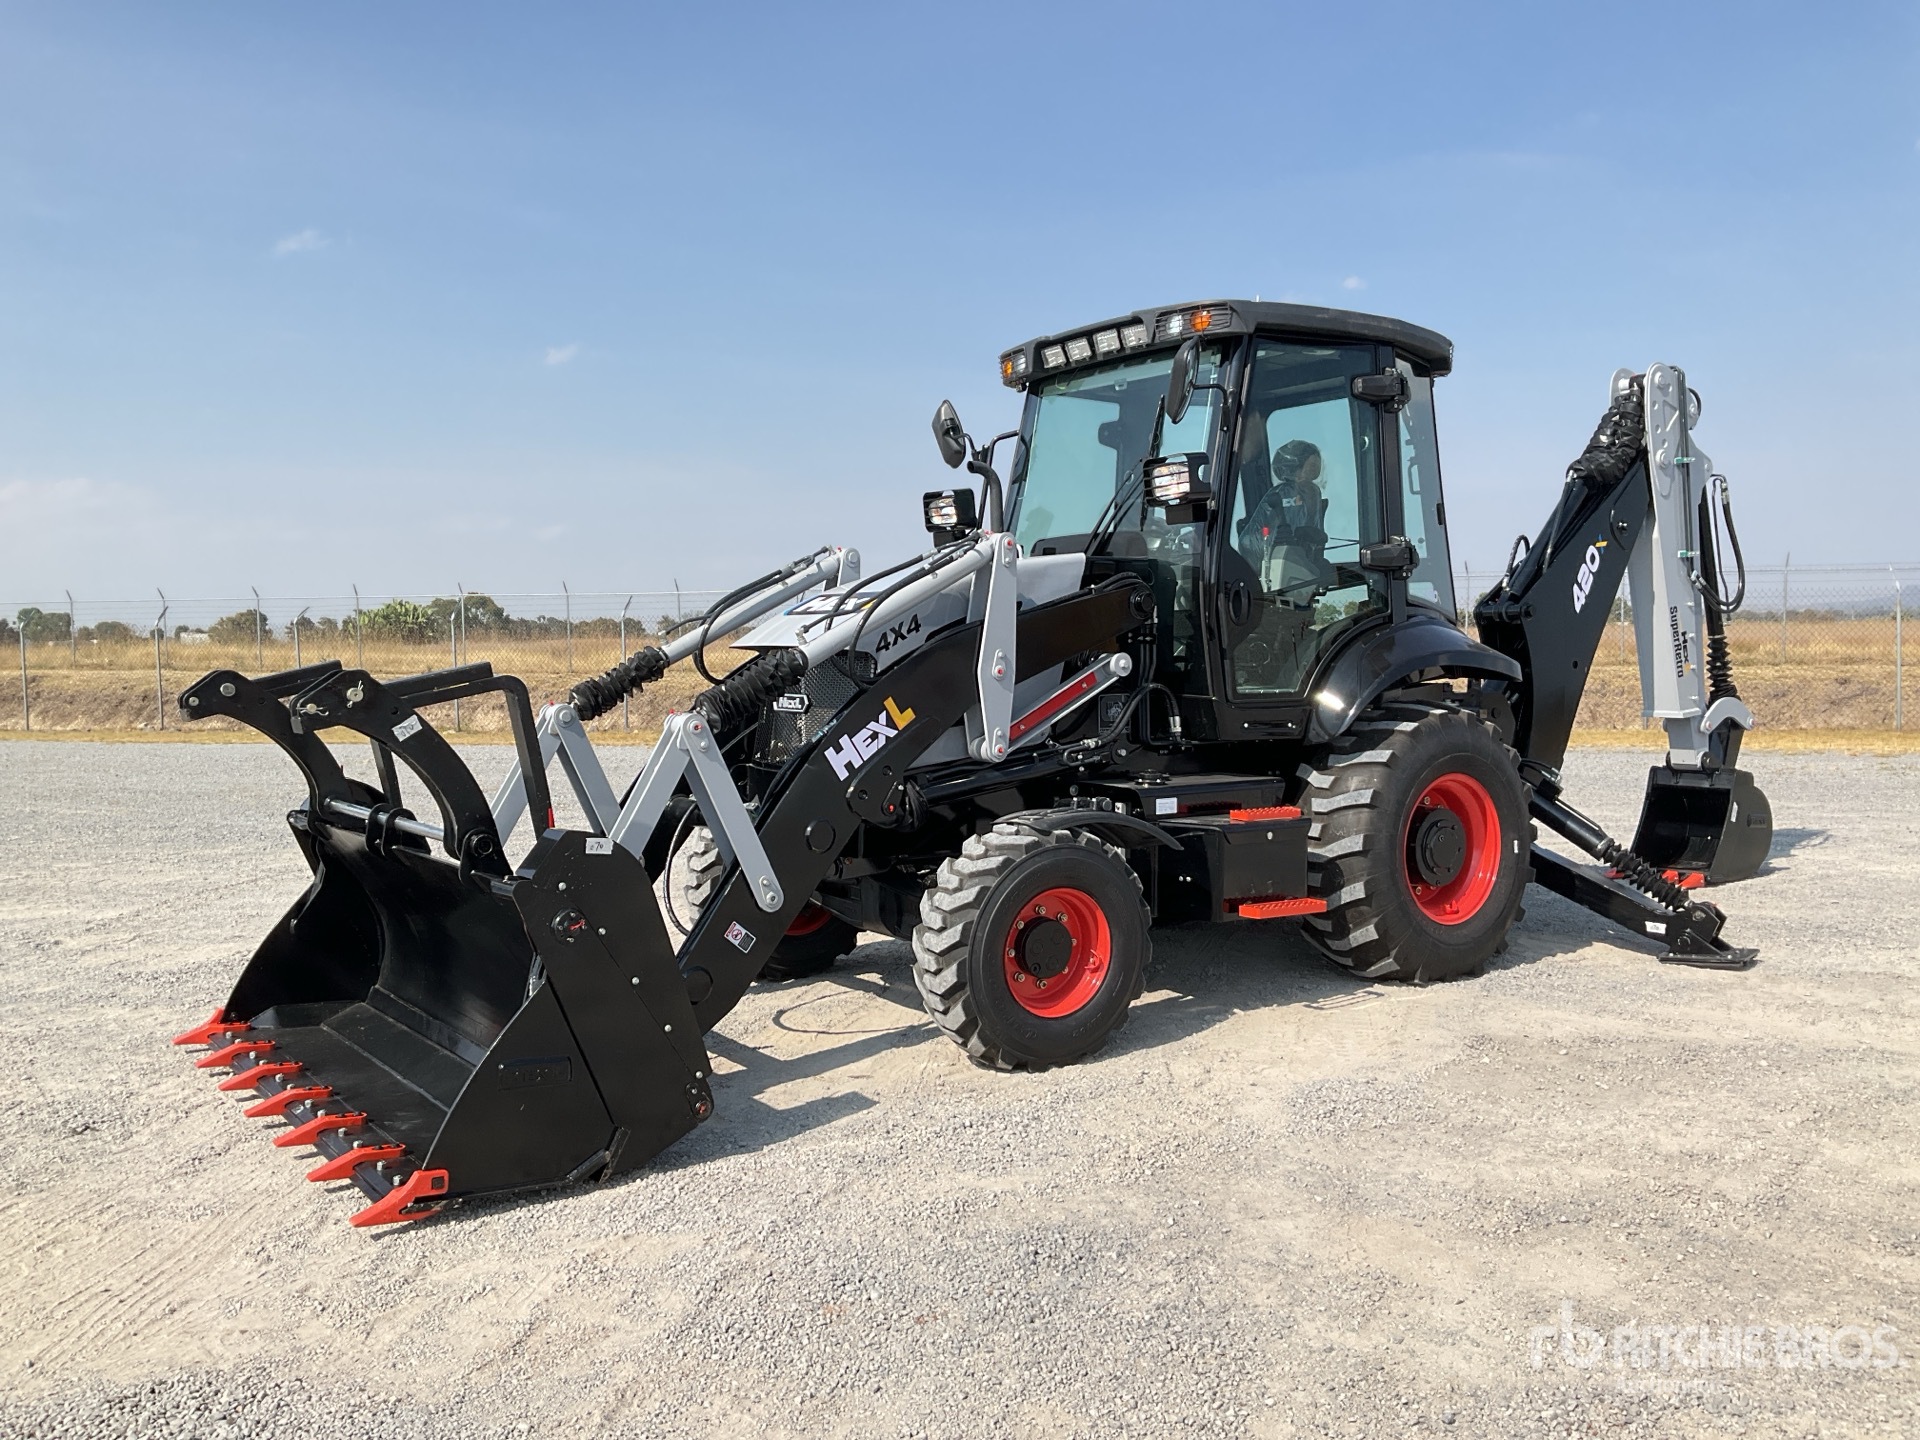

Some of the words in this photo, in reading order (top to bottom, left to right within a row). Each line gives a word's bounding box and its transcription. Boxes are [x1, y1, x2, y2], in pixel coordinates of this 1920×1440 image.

[875, 613, 922, 654] 4X4
[1670, 605, 1684, 678] SuperRetro
[824, 696, 916, 782] HEXL
